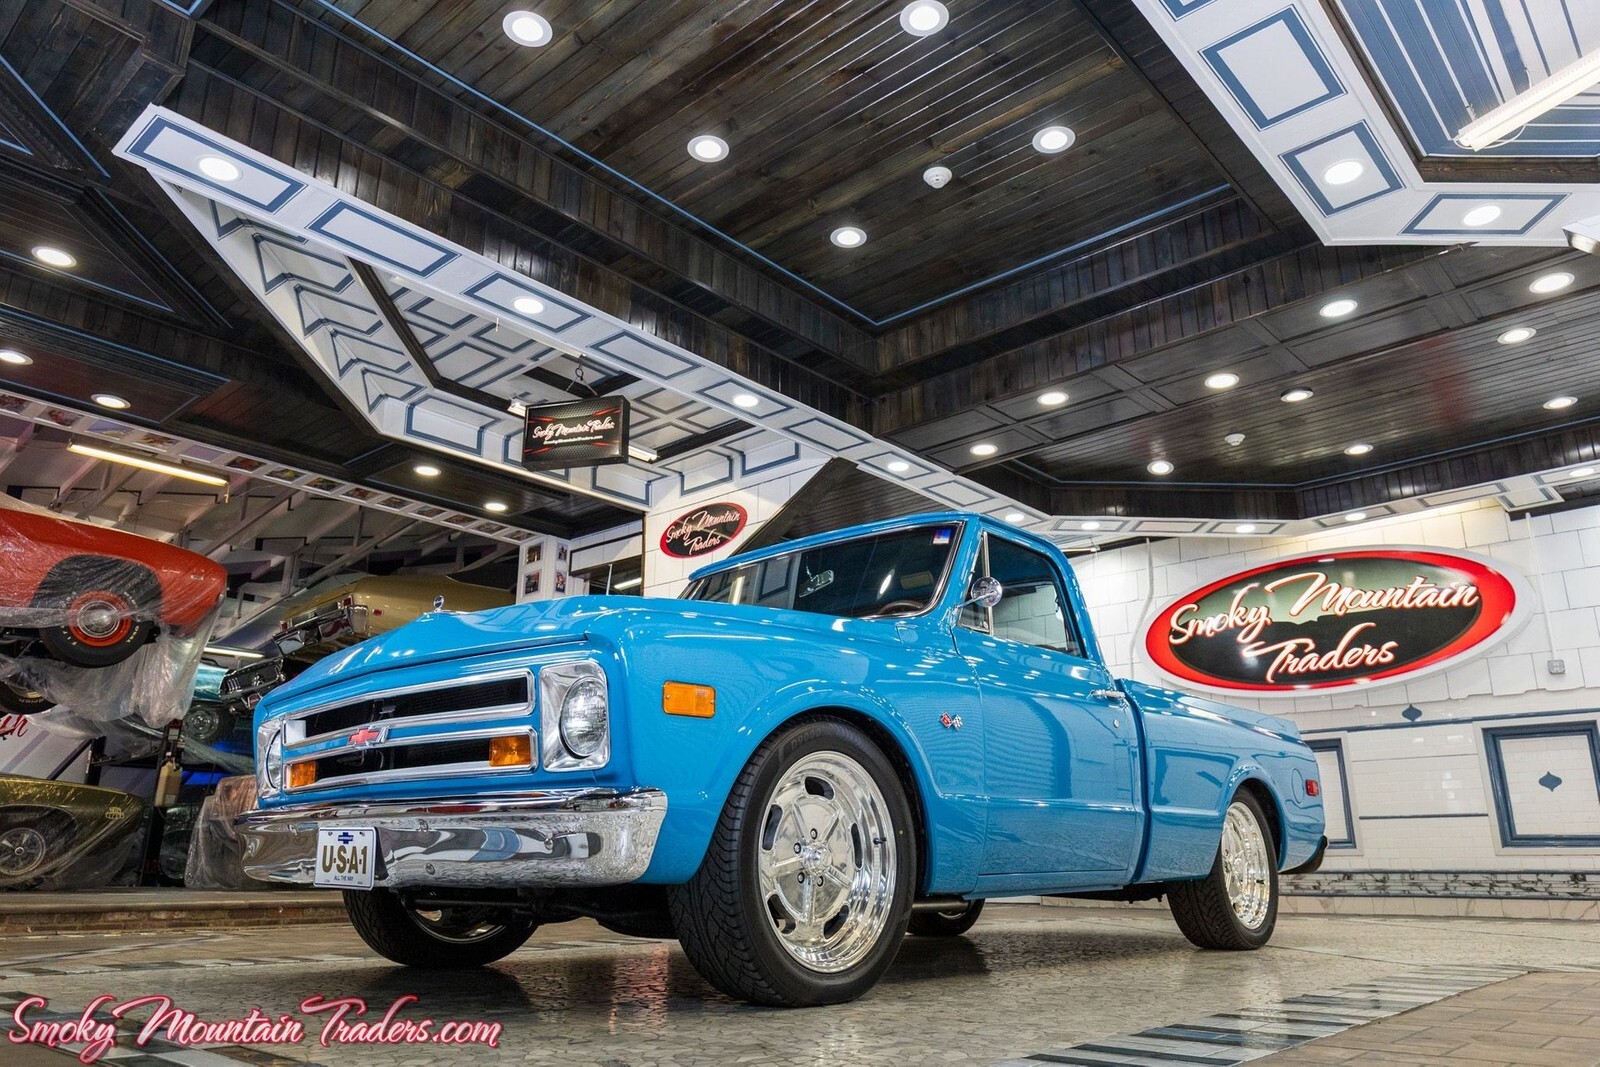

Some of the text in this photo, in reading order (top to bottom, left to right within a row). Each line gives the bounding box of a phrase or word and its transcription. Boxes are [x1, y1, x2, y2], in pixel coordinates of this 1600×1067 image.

[666, 510, 741, 543] Smoky Mountain
[684, 529, 721, 555] Traders
[1168, 571, 1480, 645] Smoky Mountain
[1242, 622, 1399, 684] Traders
